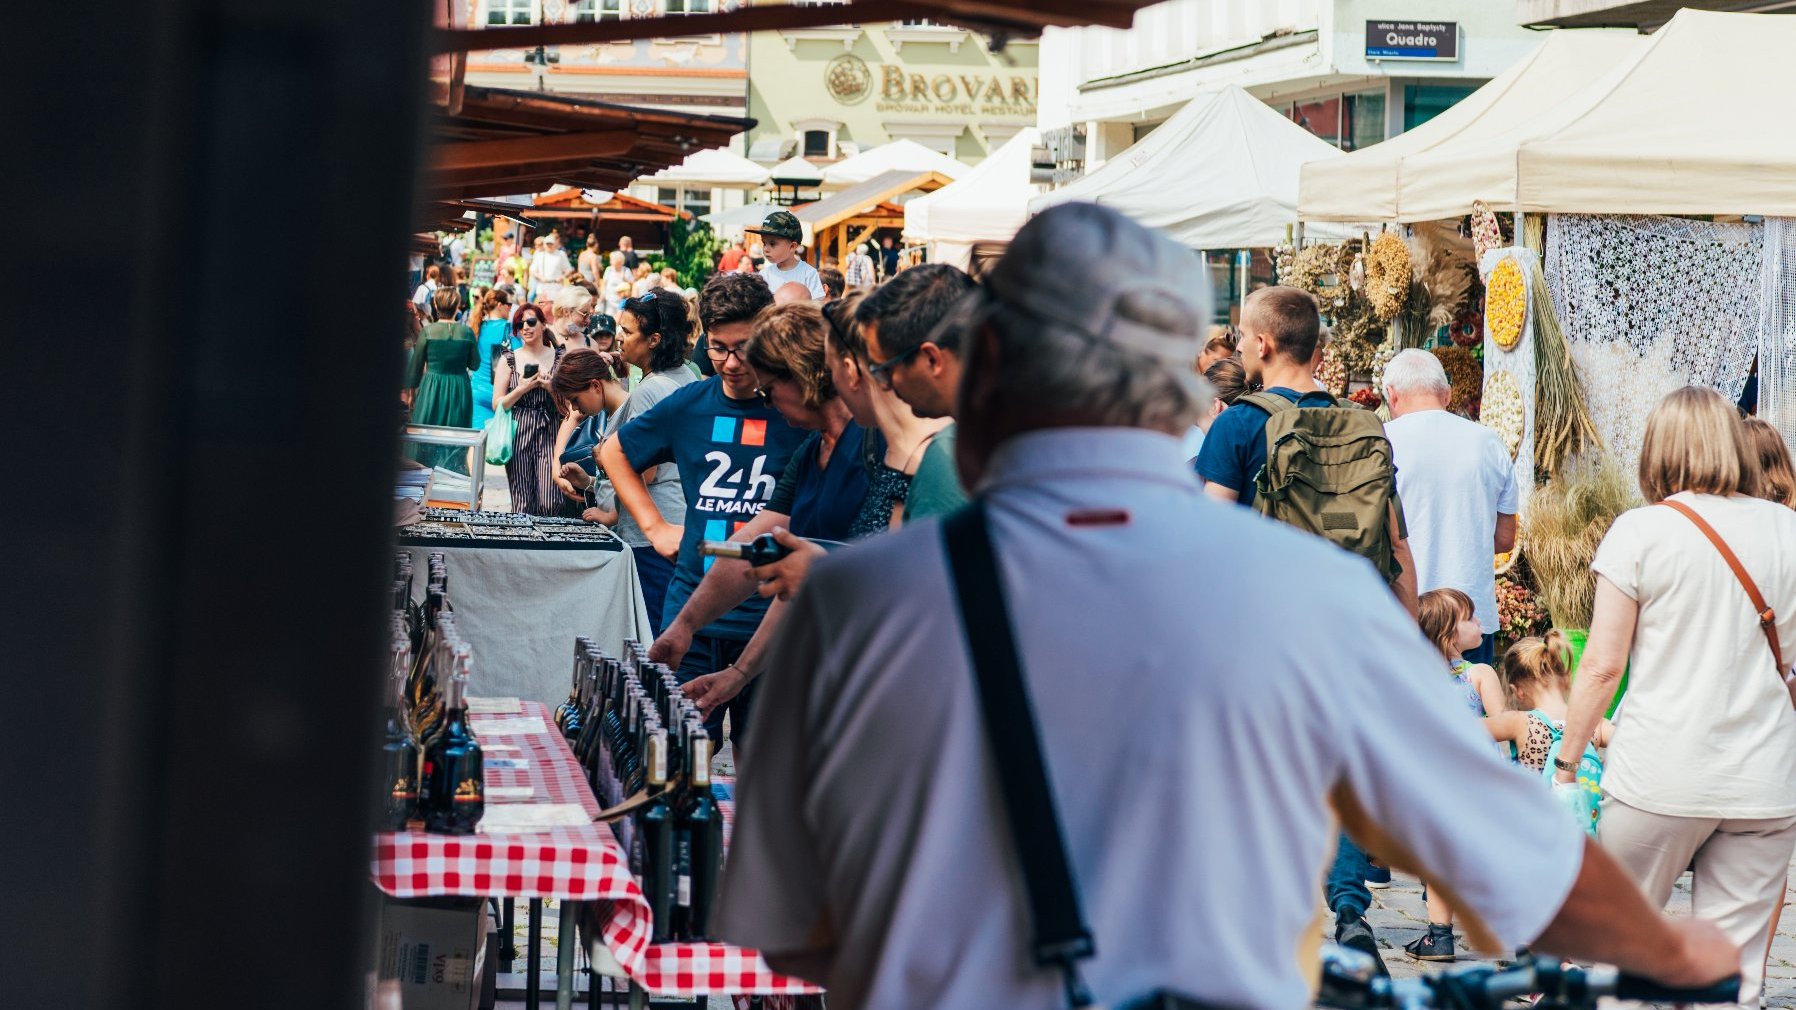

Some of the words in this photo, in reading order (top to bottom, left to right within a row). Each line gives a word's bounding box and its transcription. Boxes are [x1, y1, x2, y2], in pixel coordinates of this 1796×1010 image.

[1397, 22, 1415, 31] Jana
[1417, 22, 1446, 32] Baptysty
[1386, 32, 1437, 46] Quadro
[876, 103, 930, 113] BROWAR
[935, 104, 976, 115] HOTEL
[699, 451, 776, 500] 24h
[695, 497, 714, 511] LE
[715, 500, 767, 515] MANS
